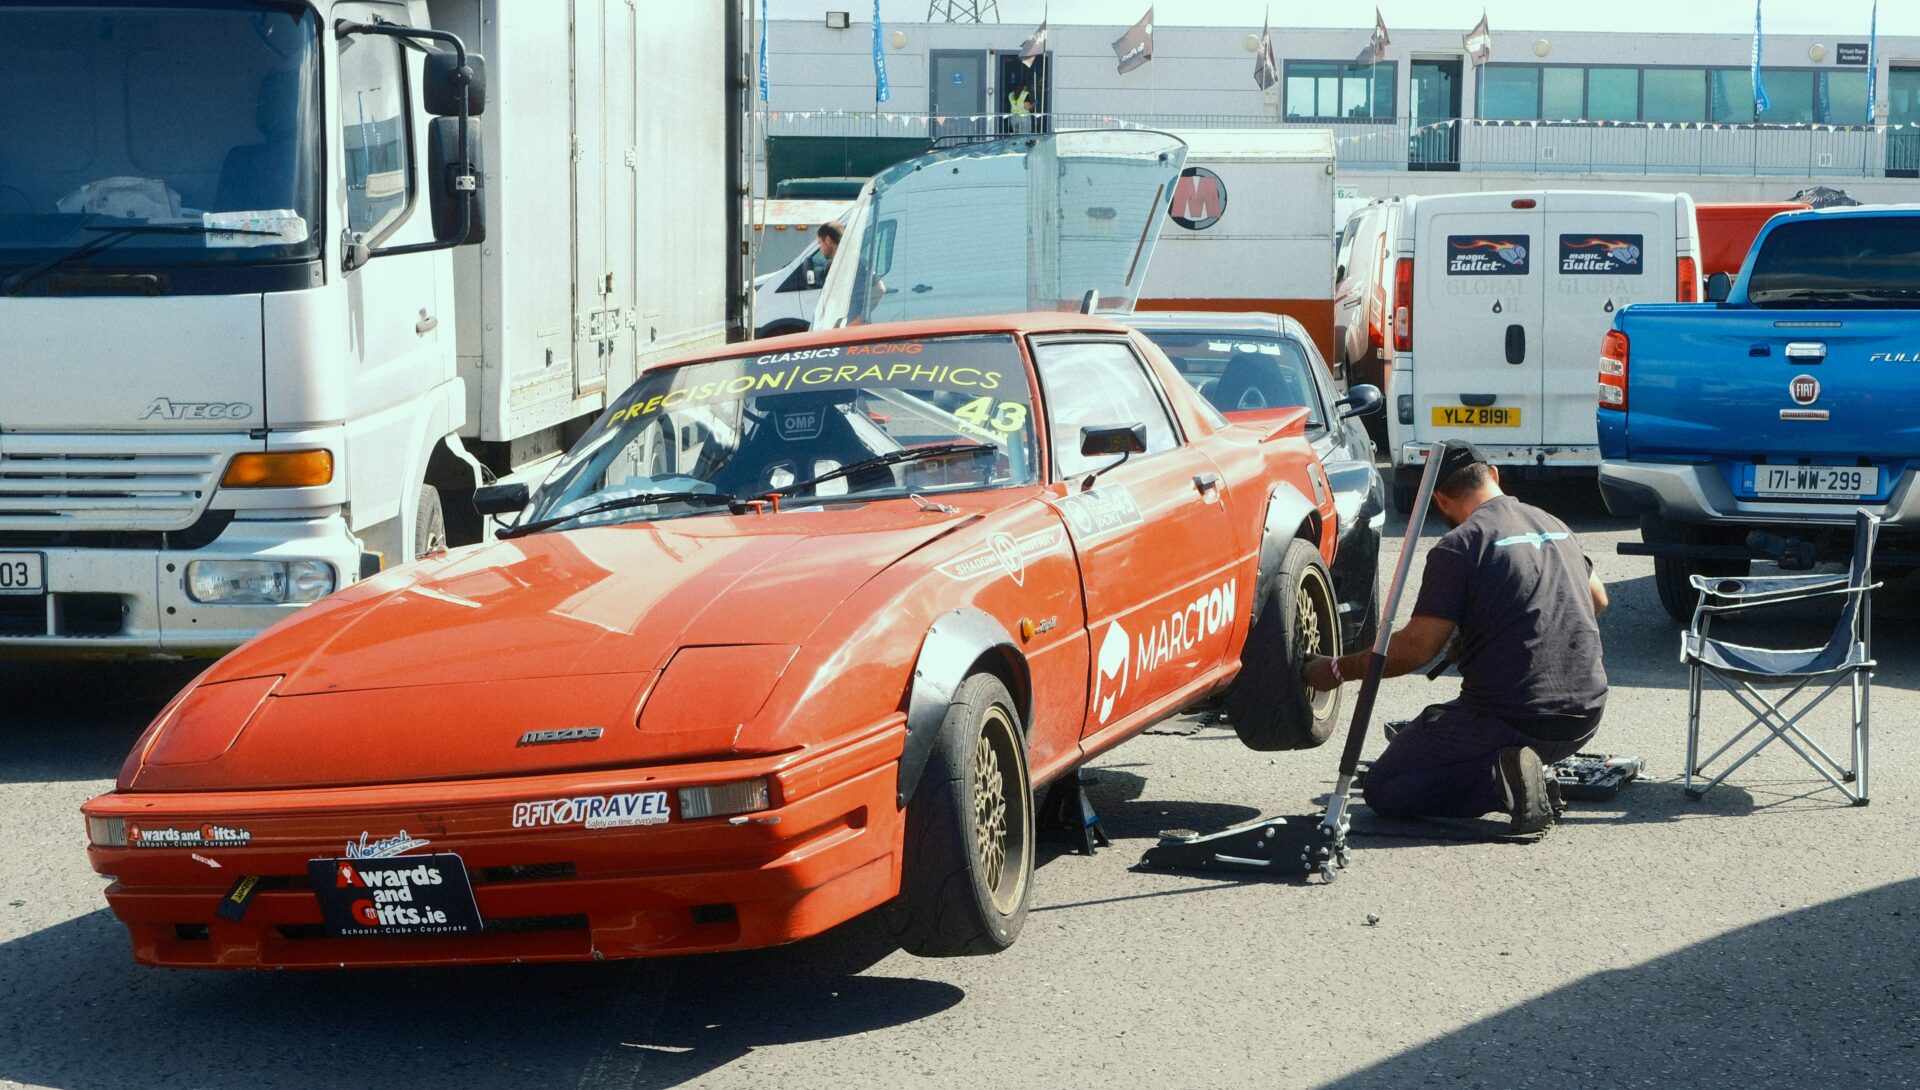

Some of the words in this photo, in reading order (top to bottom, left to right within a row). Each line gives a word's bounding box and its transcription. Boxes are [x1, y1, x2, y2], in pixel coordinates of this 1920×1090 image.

[1450, 260, 1501, 271] Bullet
[1563, 259, 1615, 270] Bullet
[757, 348, 840, 365] CLASSICS
[846, 344, 922, 356] RACING
[801, 364, 1003, 390] GRAPHICS
[1796, 383, 1814, 397] FIAT
[785, 416, 815, 430] OMP
[953, 396, 1028, 432] 43
[1444, 409, 1475, 424] YLZ
[1479, 409, 1508, 424] 8191
[1768, 470, 1861, 491] 171-WW-299
[0, 562, 28, 587] 03
[955, 553, 997, 575] SHADOW
[1136, 577, 1236, 681] MARCTON
[574, 794, 668, 819] TRAVEL
[129, 824, 180, 841] Awards
[182, 831, 200, 841] and
[201, 823, 250, 840] Gifts.ie
[587, 820, 606, 828] Safety
[634, 817, 667, 827] everytime
[336, 862, 443, 888] Awards
[373, 885, 413, 902] and
[351, 900, 447, 926] Gifts.ie
[420, 925, 467, 933] Corporate
